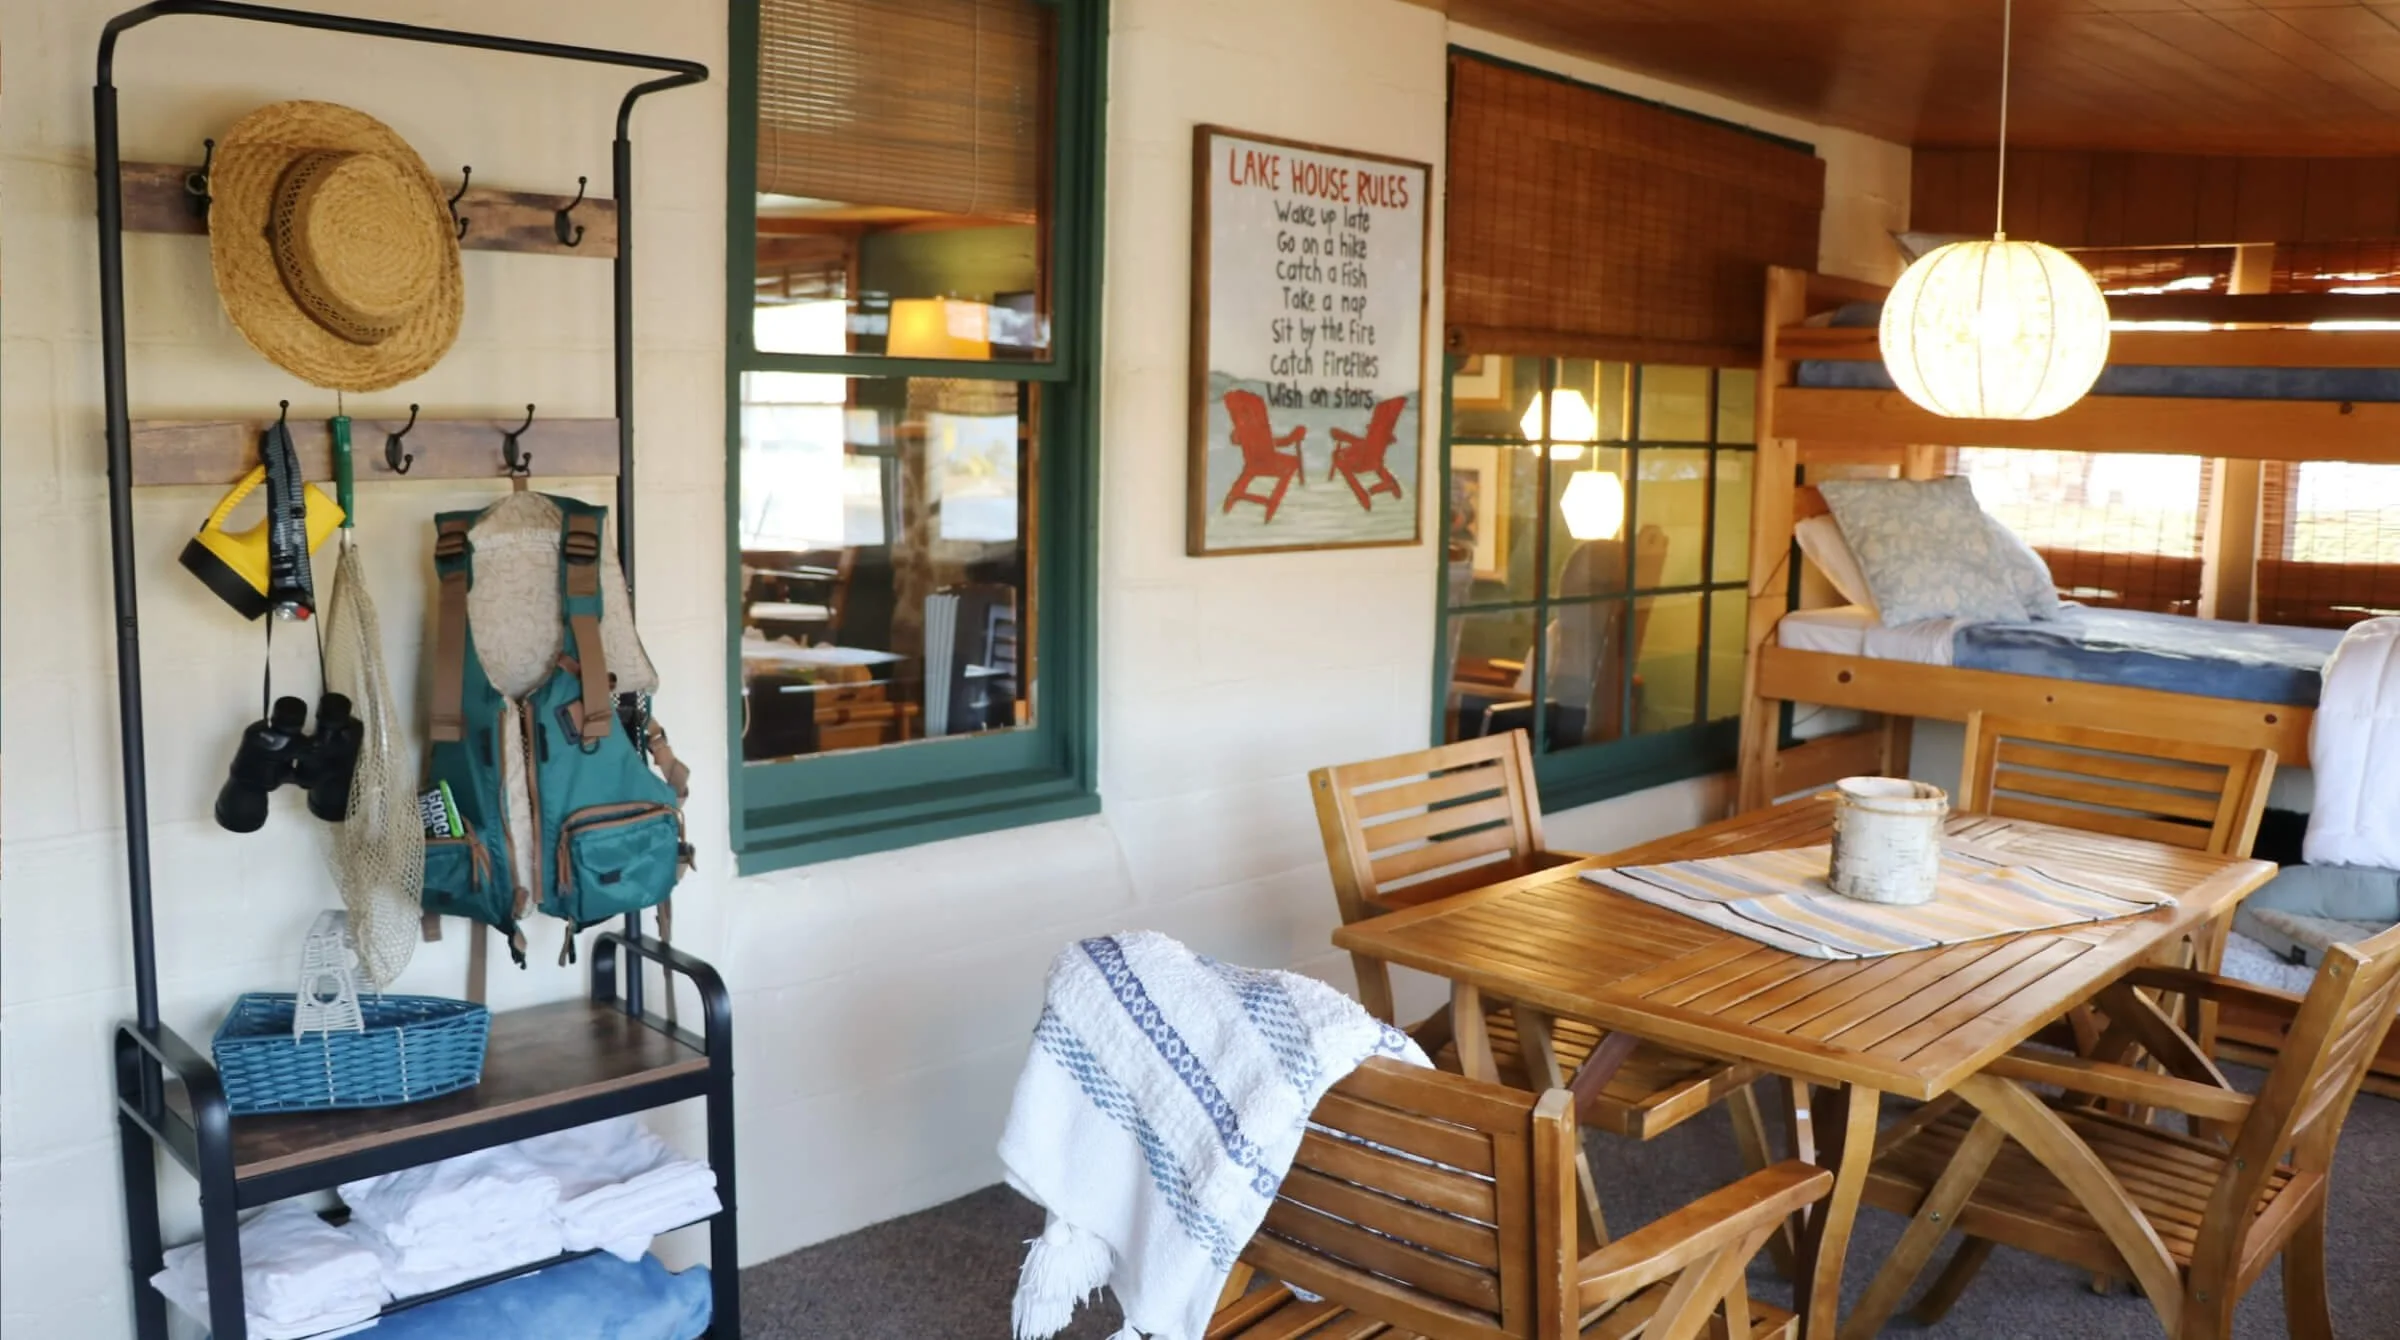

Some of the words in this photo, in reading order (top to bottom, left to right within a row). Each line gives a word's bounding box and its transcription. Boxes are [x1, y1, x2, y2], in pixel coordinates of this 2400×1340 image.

[1229, 148, 1280, 192] LAKE
[1292, 158, 1350, 202] HOUSE
[1357, 170, 1409, 208] RULES
[1274, 199, 1316, 227] Wake
[1321, 208, 1337, 235] up
[1343, 205, 1370, 232] late
[1277, 230, 1295, 252] Go
[1302, 237, 1319, 255] on
[1324, 238, 1334, 256] a
[1340, 231, 1367, 259] hike
[1276, 255, 1322, 283] Catch
[1328, 266, 1337, 283] a
[1282, 286, 1316, 312] Take
[1323, 294, 1332, 311] a
[1341, 295, 1367, 320] nap
[1271, 317, 1294, 344] Sit
[1300, 317, 1316, 349] by
[1321, 316, 1344, 342] the
[1270, 348, 1313, 376] Catch
[1266, 379, 1303, 409] Wish
[1310, 386, 1329, 408] on
[1334, 381, 1374, 411] stars
